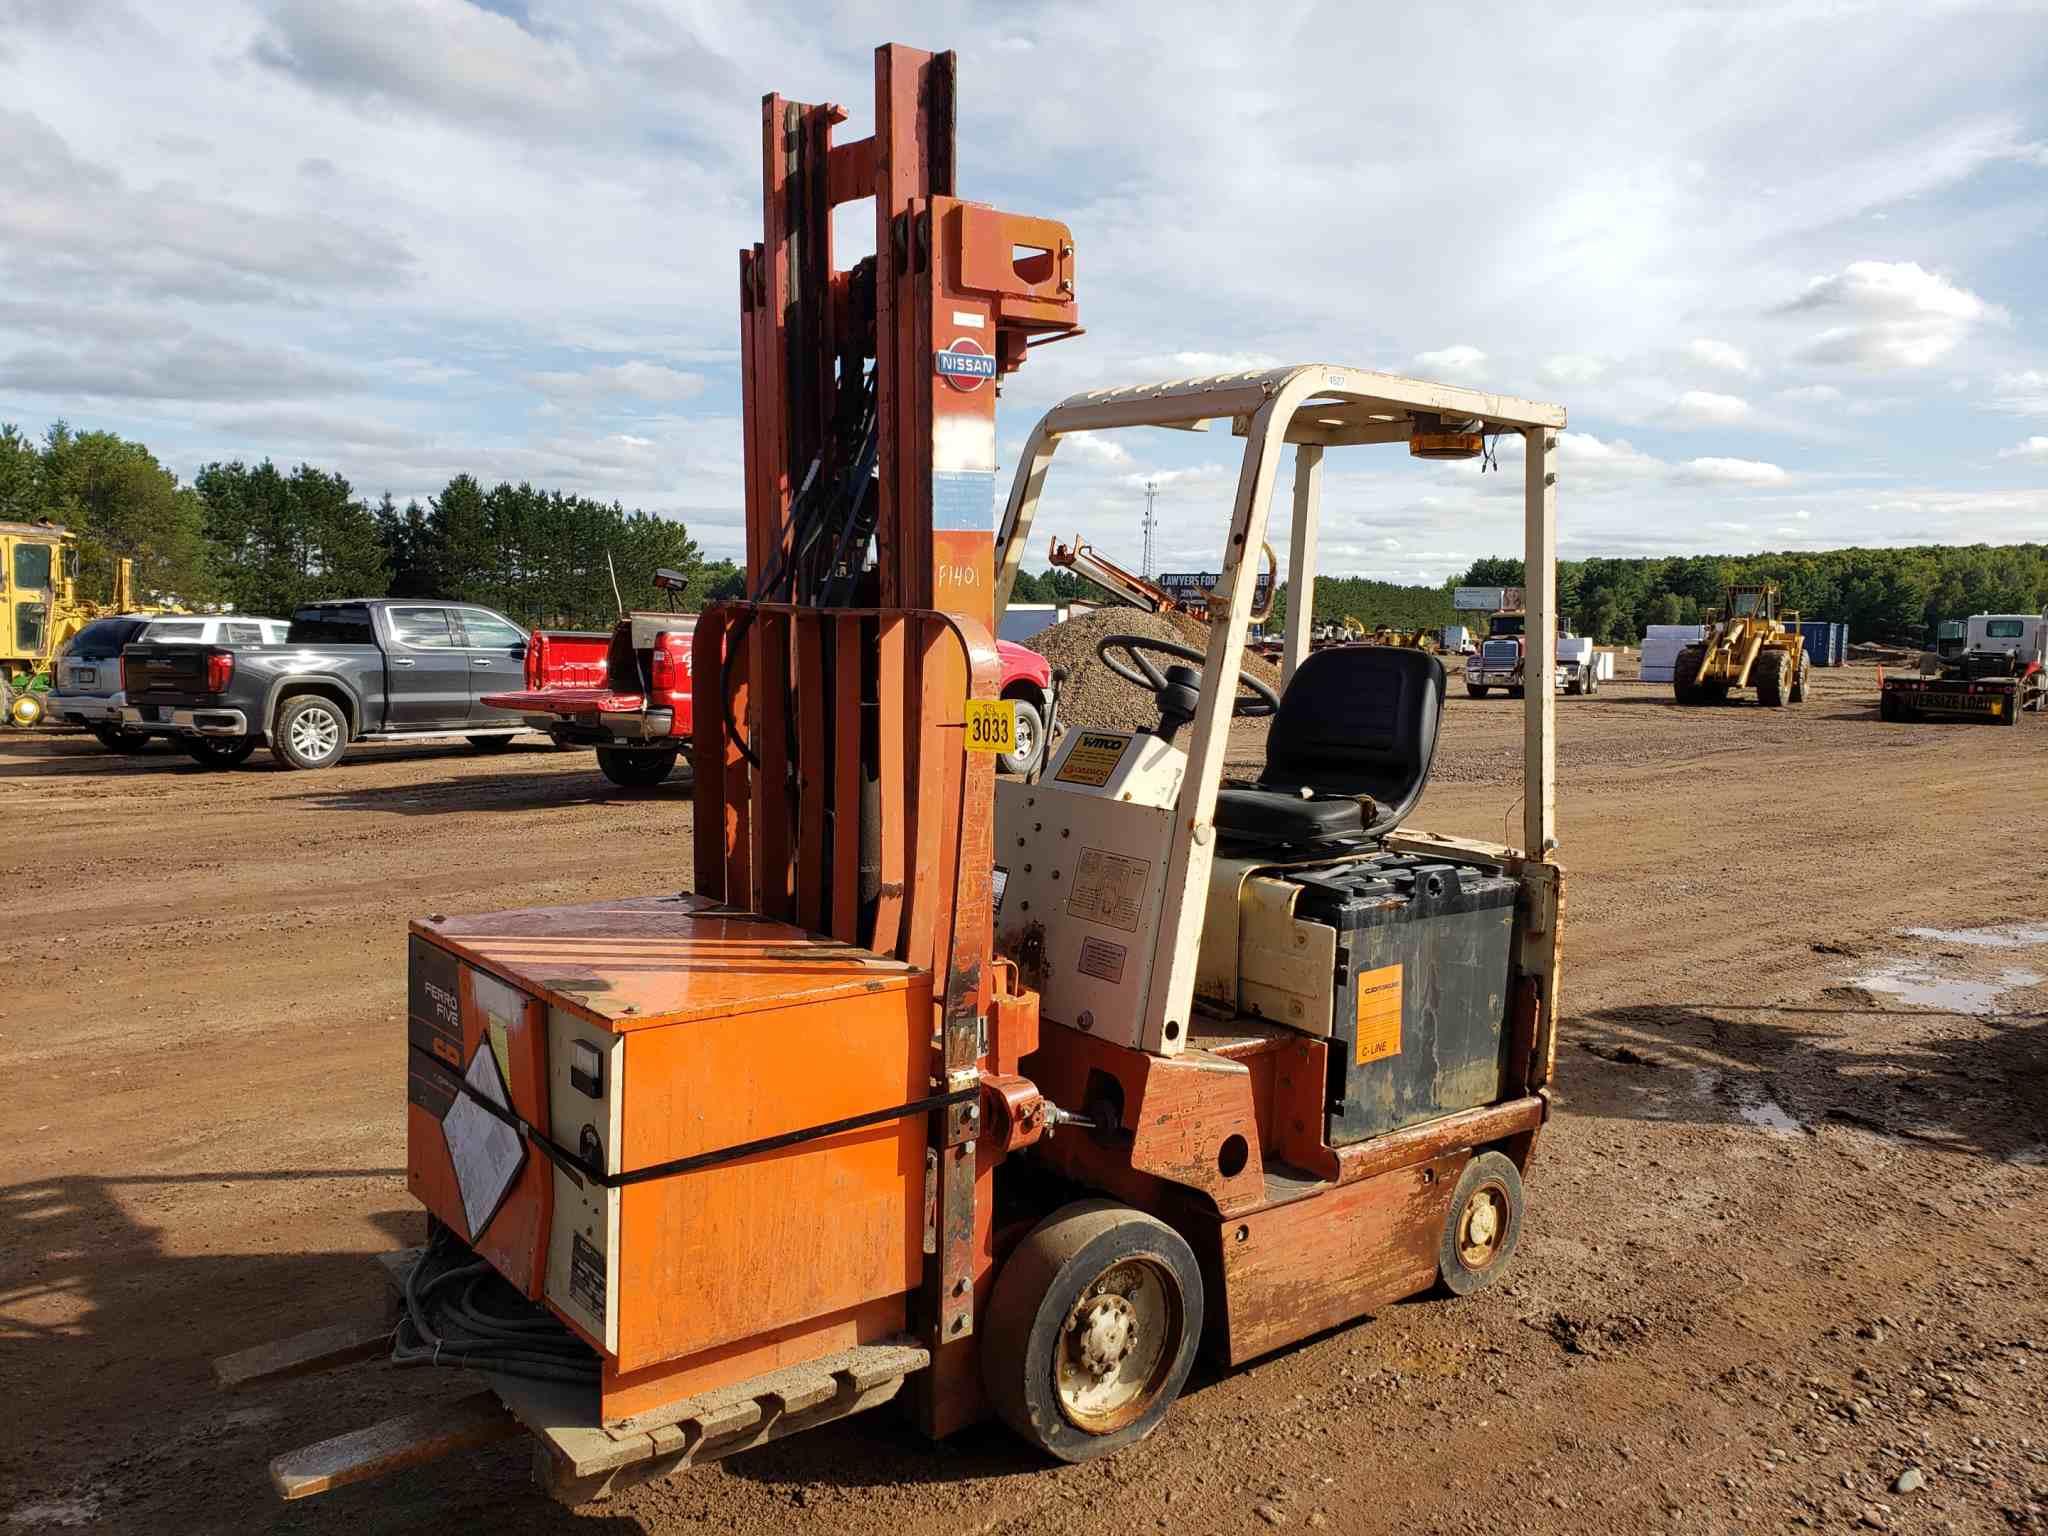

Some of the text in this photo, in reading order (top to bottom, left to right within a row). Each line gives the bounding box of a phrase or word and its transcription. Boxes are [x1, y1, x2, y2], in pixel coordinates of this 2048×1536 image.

[943, 356, 992, 373] NISSAN
[1162, 575, 1217, 586] LAWYERS FOR
[972, 717, 1009, 744] 3033
[424, 981, 458, 1011] FERRO
[435, 1002, 459, 1027] FIVE
